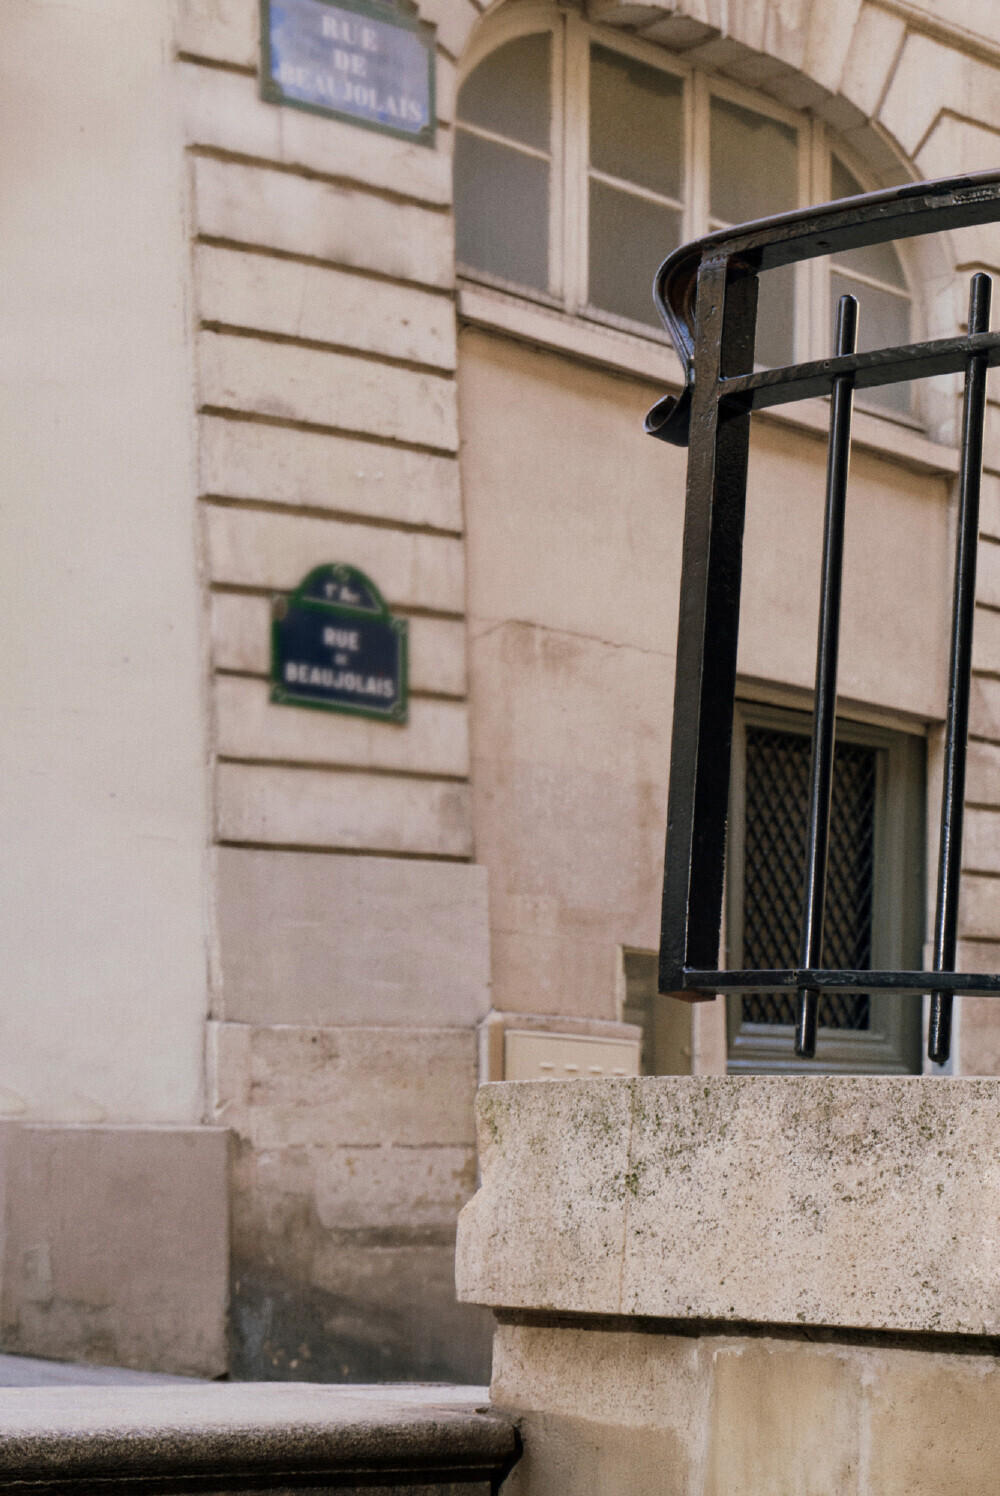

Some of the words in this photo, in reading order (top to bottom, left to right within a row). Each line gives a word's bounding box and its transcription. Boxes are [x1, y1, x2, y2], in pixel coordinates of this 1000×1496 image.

[322, 15, 378, 51] RUE
[323, 626, 360, 651] RUE
[285, 662, 395, 698] BEAUJOLAIS
